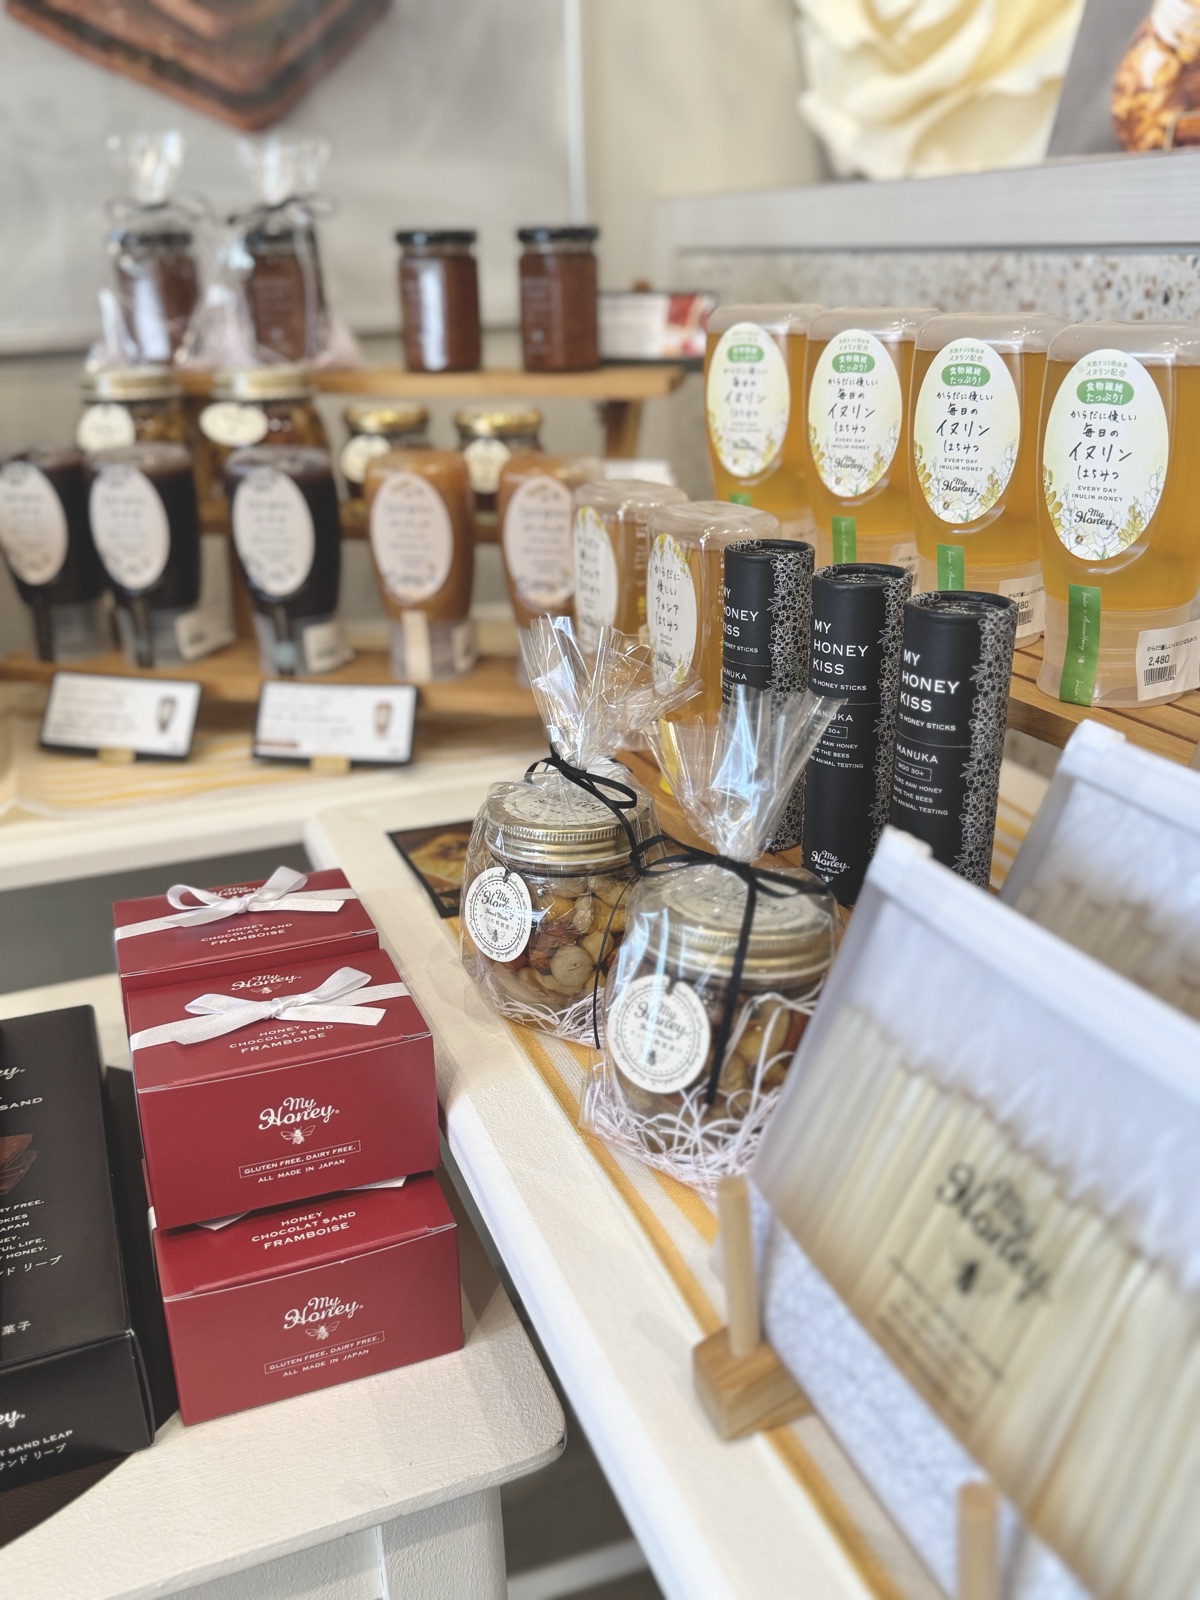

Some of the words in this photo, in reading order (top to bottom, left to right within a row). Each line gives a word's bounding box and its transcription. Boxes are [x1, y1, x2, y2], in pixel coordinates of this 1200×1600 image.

[1086, 368, 1126, 378] イヌリン配合
[1086, 381, 1124, 393] 食物繊維
[936, 391, 993, 402] からだに優しい
[828, 403, 875, 419] イヌリン
[947, 402, 978, 416] 毎日の
[1070, 409, 1137, 423] からだに優しい
[834, 421, 867, 435] はちみつ
[936, 419, 990, 437] イヌリン
[1082, 422, 1119, 438] 毎日の
[944, 440, 979, 454] はちみつ
[1068, 441, 1133, 463] イヌリン
[1077, 465, 1119, 482] はちみつ
[814, 619, 832, 634] MY
[737, 645, 759, 654] STICKS
[813, 638, 869, 657] HONEY
[903, 649, 920, 666] MY
[1148, 654, 1170, 667] 2,480
[812, 657, 845, 675] KISS
[818, 680, 839, 689] HONEY
[901, 669, 960, 694] HONEY
[900, 690, 932, 712] KISS
[903, 715, 925, 727] HONEY
[926, 722, 956, 732] STICKS
[821, 748, 832, 756] THE
[896, 742, 939, 764] MANUKA
[816, 757, 836, 767] ANIMAL
[911, 767, 924, 776] 30+
[905, 780, 918, 790] RAW
[919, 785, 943, 794] HONEY
[903, 790, 914, 799] THE
[915, 794, 934, 804] BEES
[898, 799, 918, 811] ANIMAL
[919, 806, 949, 816] TESTING
[822, 850, 838, 861] My
[201, 928, 260, 942] CHOCOLAT
[263, 923, 293, 931] SAND
[227, 923, 264, 933] HONEY
[211, 929, 286, 946] FRAMBOISE
[229, 1032, 297, 1049] CHOCOLAT
[300, 1024, 334, 1034] SAND
[259, 1025, 301, 1037] HONEY
[241, 1032, 327, 1053] FRAMBOISE
[283, 1097, 317, 1112] My
[244, 1162, 278, 1175] GLUTEN
[279, 1157, 304, 1168] FREE.
[305, 1150, 330, 1161] DAIRY
[332, 1145, 356, 1155] FREE.
[257, 1174, 274, 1183] ALL
[277, 1168, 302, 1179] MADE
[305, 1165, 315, 1173] IN
[318, 1158, 346, 1170] JAPAN
[14, 1199, 45, 1210] FREE.
[251, 1220, 319, 1242] CHOCOLAT
[322, 1211, 356, 1224] SAND
[281, 1211, 323, 1227] HONEY
[263, 1221, 350, 1250] FRAMBOISE
[6, 1246, 48, 1260] HONEY.
[308, 1296, 341, 1310] My
[2, 1320, 31, 1336] 菓子
[269, 1357, 303, 1370] GLUTEN
[304, 1350, 329, 1361] FREE.
[330, 1343, 355, 1354] DAIRY
[356, 1335, 380, 1345] FREE.
[283, 1369, 299, 1377] ALL
[302, 1362, 326, 1371] MADE
[330, 1357, 339, 1365] IN
[343, 1348, 369, 1361] JAPAN
[8, 1440, 40, 1454] SAND
